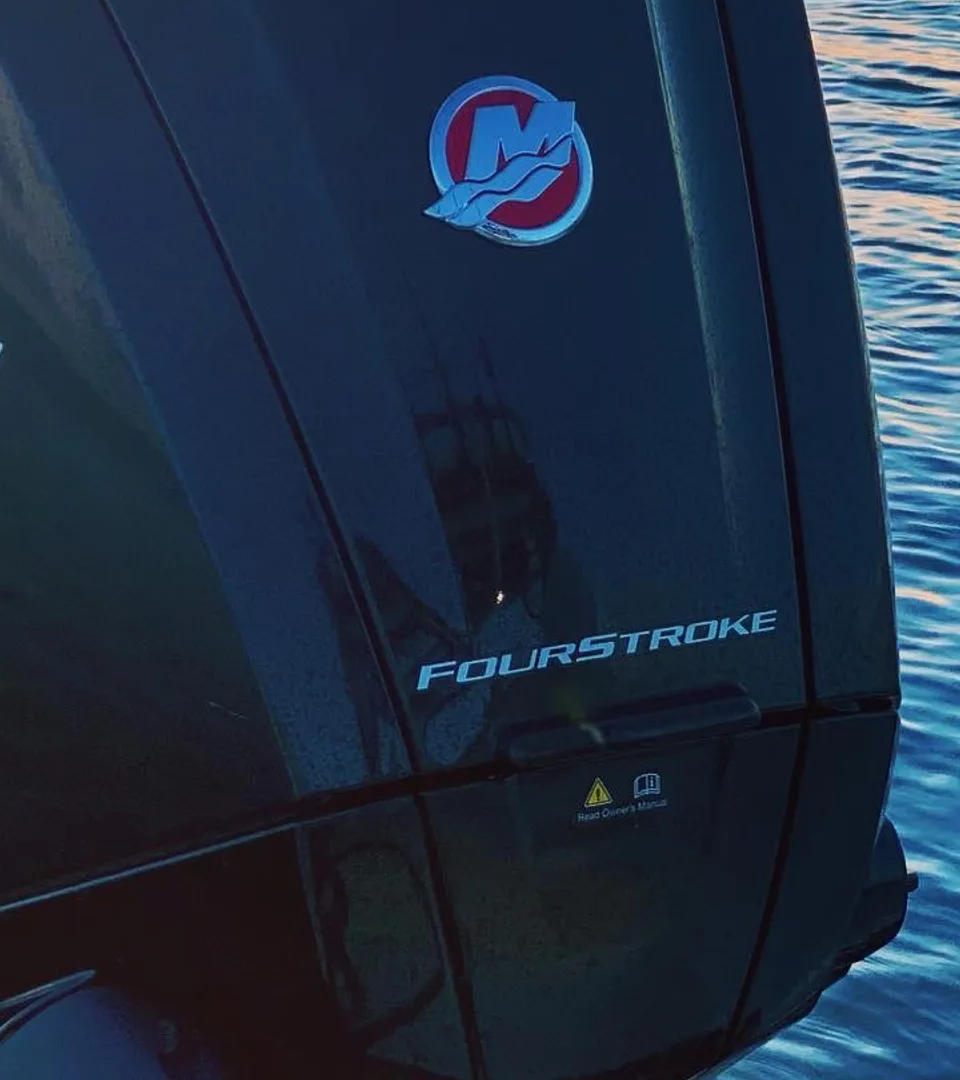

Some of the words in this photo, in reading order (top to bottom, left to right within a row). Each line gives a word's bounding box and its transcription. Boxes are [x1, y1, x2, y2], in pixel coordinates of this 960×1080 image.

[416, 610, 778, 691] FOURSTROKE
[577, 812, 600, 822] Read
[602, 804, 636, 818] Owner's
[637, 799, 668, 811] Manual
